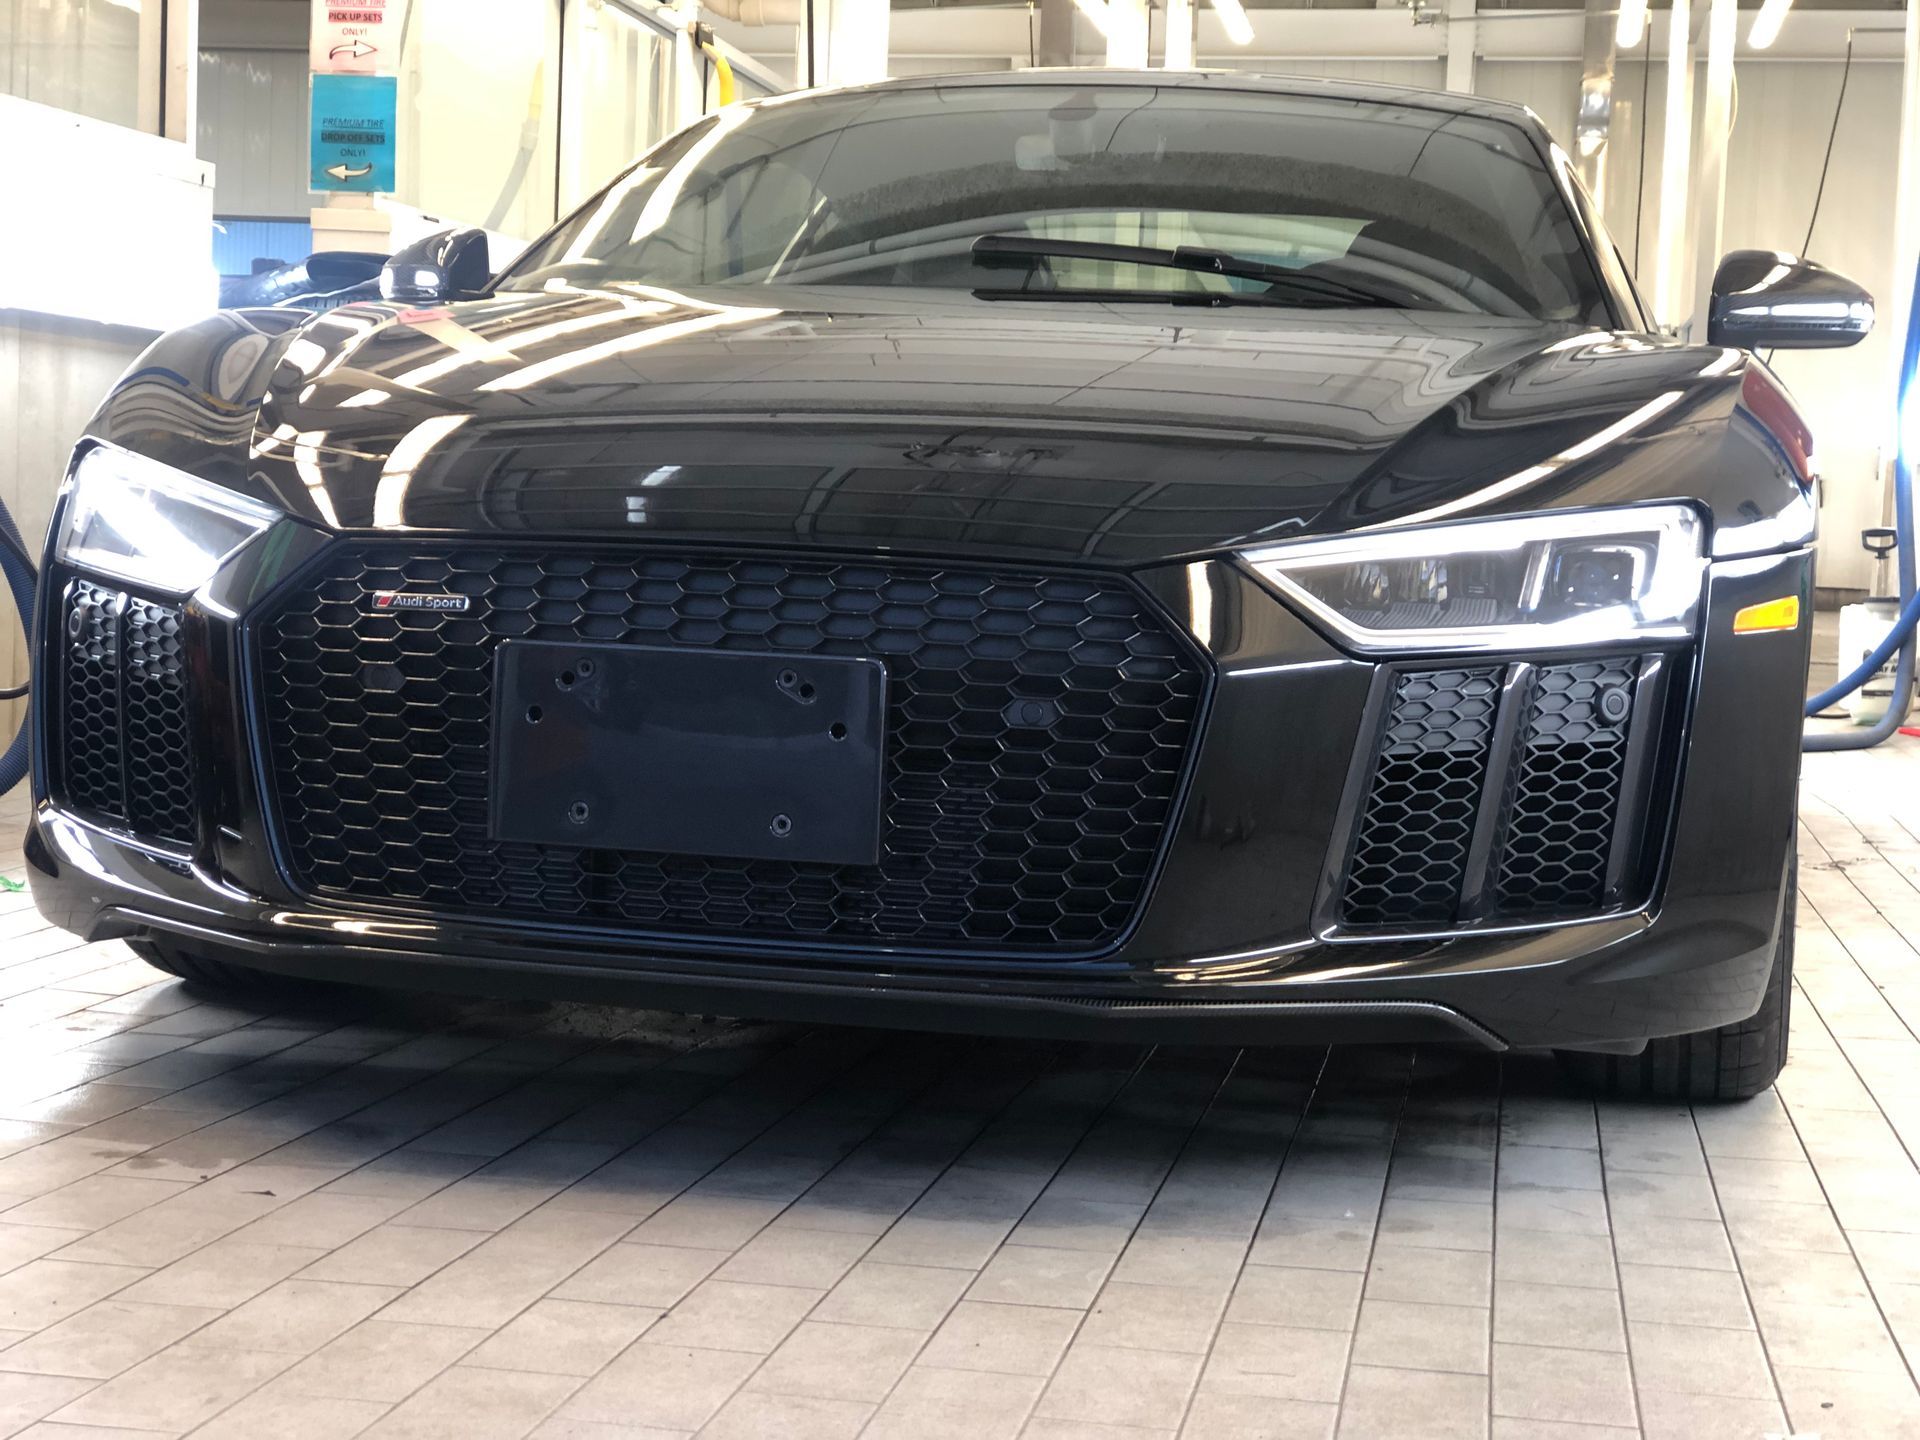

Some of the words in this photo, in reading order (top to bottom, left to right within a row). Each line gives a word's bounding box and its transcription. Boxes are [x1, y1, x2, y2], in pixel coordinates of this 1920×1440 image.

[328, 12, 348, 20] PICK
[349, 12, 362, 21] UP
[363, 13, 383, 22] SETS
[342, 27, 368, 36] ONLY!
[322, 117, 365, 128] PREMIUM
[366, 119, 385, 129] TIRE
[321, 132, 346, 142] DROP
[347, 132, 363, 143] OFF
[366, 134, 385, 144] SETS
[340, 148, 366, 157] ONLY!
[393, 595, 423, 607] Audi
[425, 596, 462, 609] Sport
